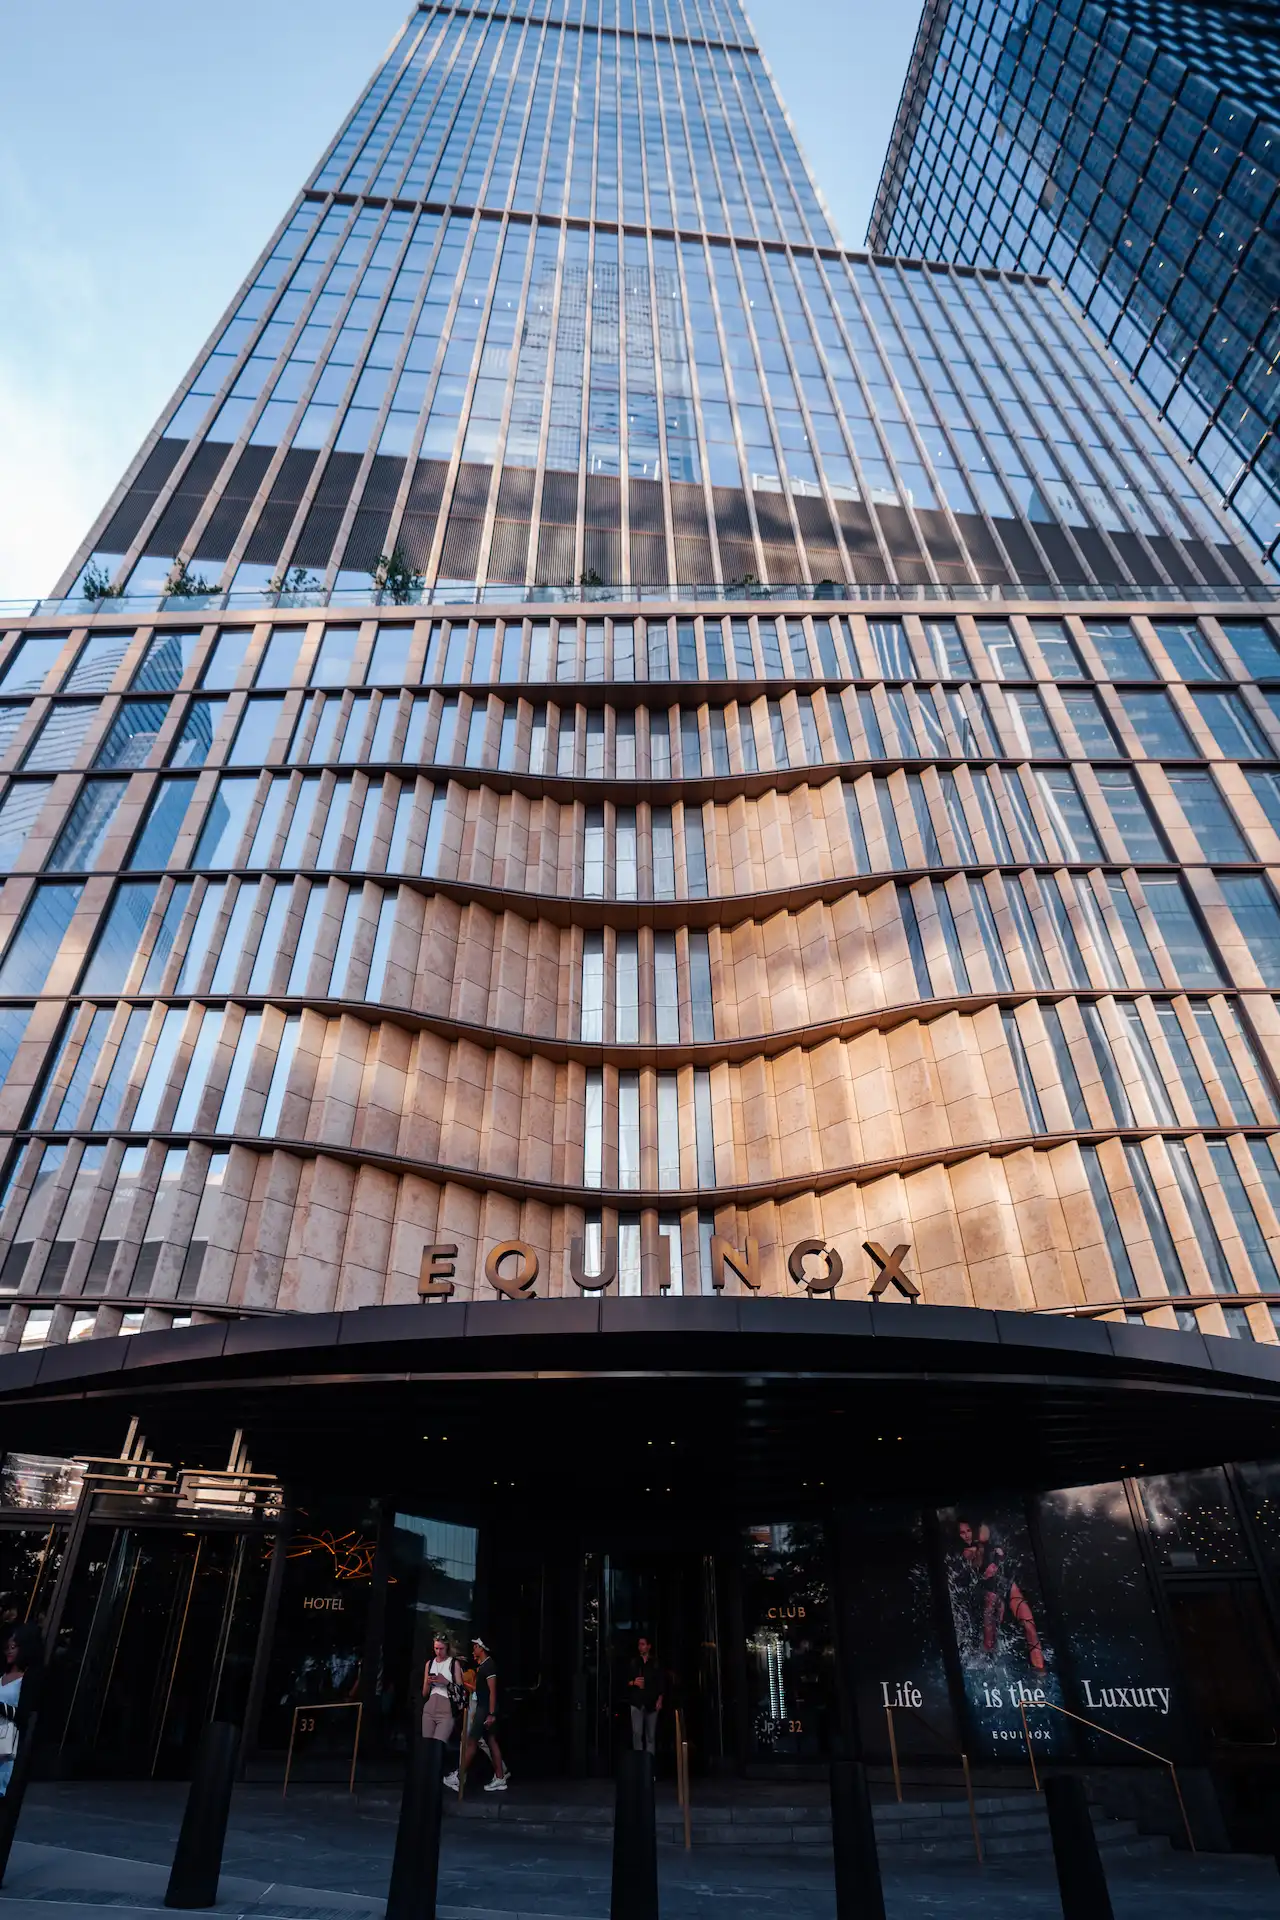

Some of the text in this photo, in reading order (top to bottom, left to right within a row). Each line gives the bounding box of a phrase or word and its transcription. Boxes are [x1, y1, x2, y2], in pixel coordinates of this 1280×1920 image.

[417, 1234, 918, 1299] EQUINOX
[303, 1597, 345, 1611] HOTEL
[767, 1606, 806, 1619] CLUB
[880, 1679, 1170, 1714] Life is the Luxury
[300, 1719, 315, 1732] 33
[788, 1720, 803, 1733] 32
